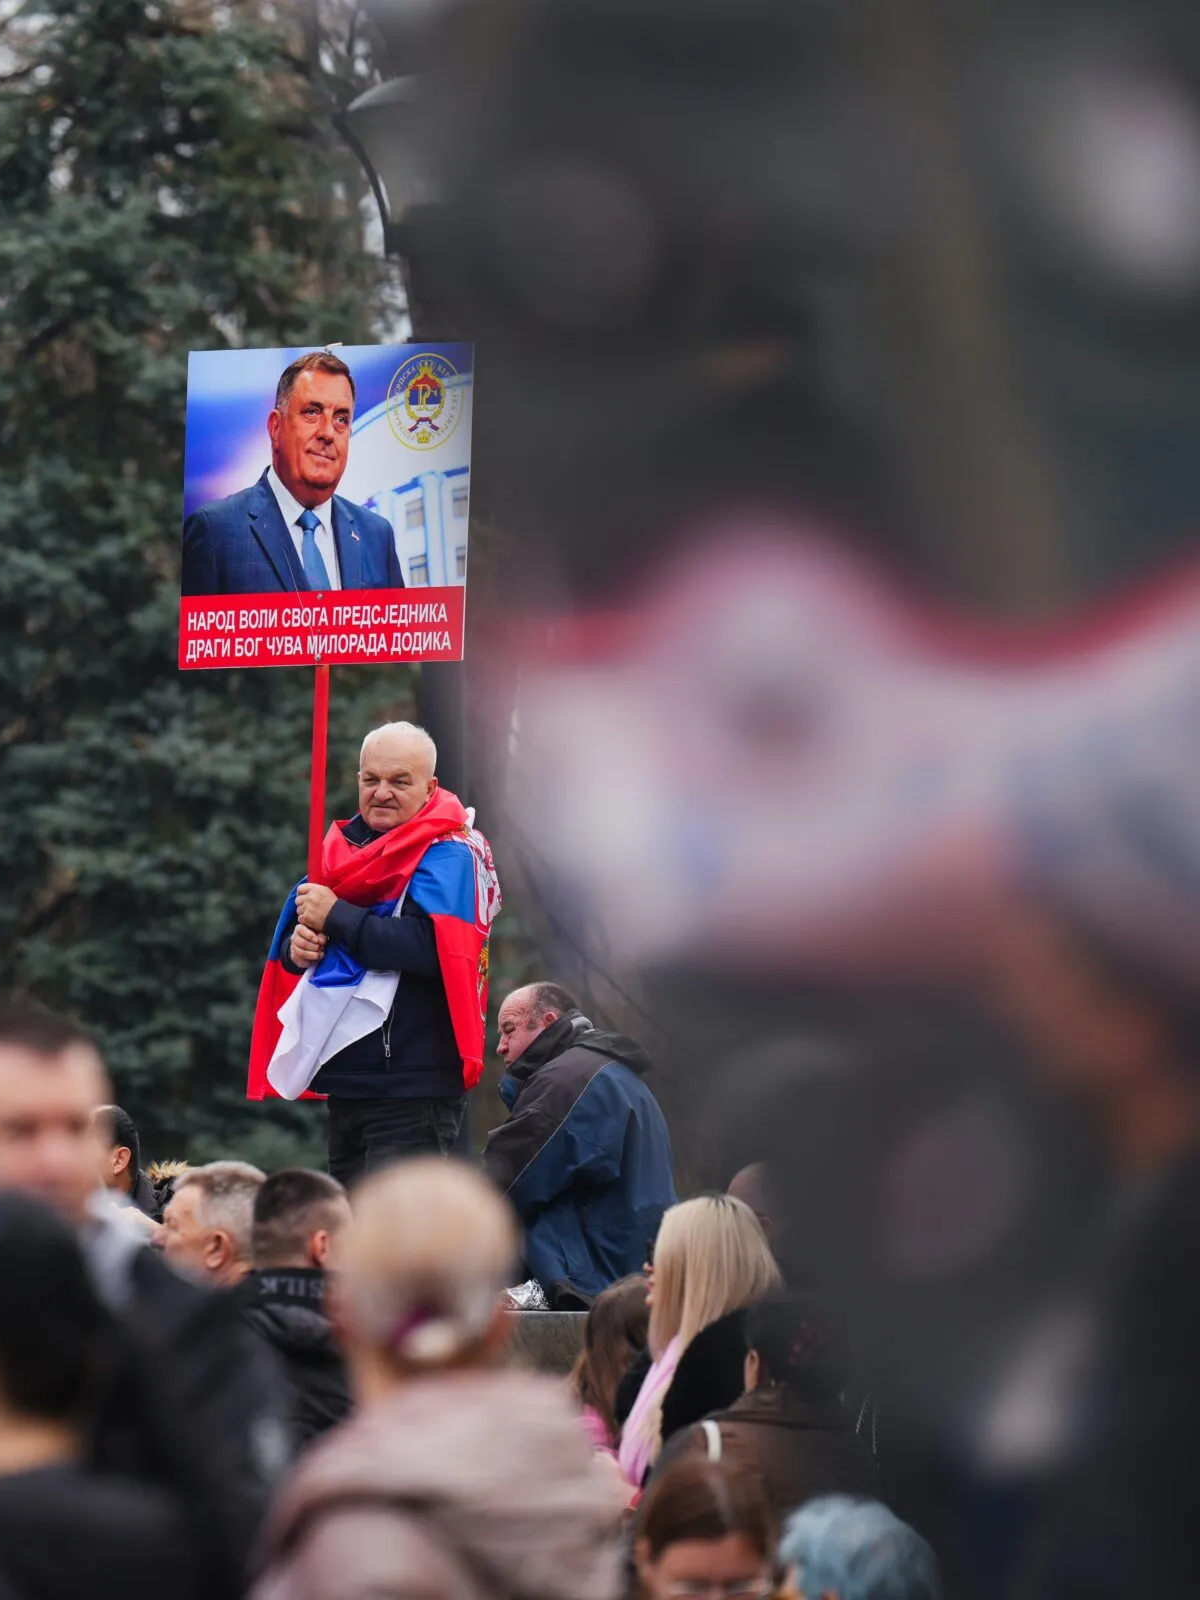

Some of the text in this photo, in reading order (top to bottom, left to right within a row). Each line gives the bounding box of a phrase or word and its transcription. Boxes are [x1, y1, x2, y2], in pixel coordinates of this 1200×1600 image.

[187, 603, 448, 633] НАРОД ВОЛИ СВОГА ПРЕДСЈЕДНИКА
[186, 630, 452, 662] ДРАГИ БОГ ЧУВА МИЛОРАДА ДОДИКА
